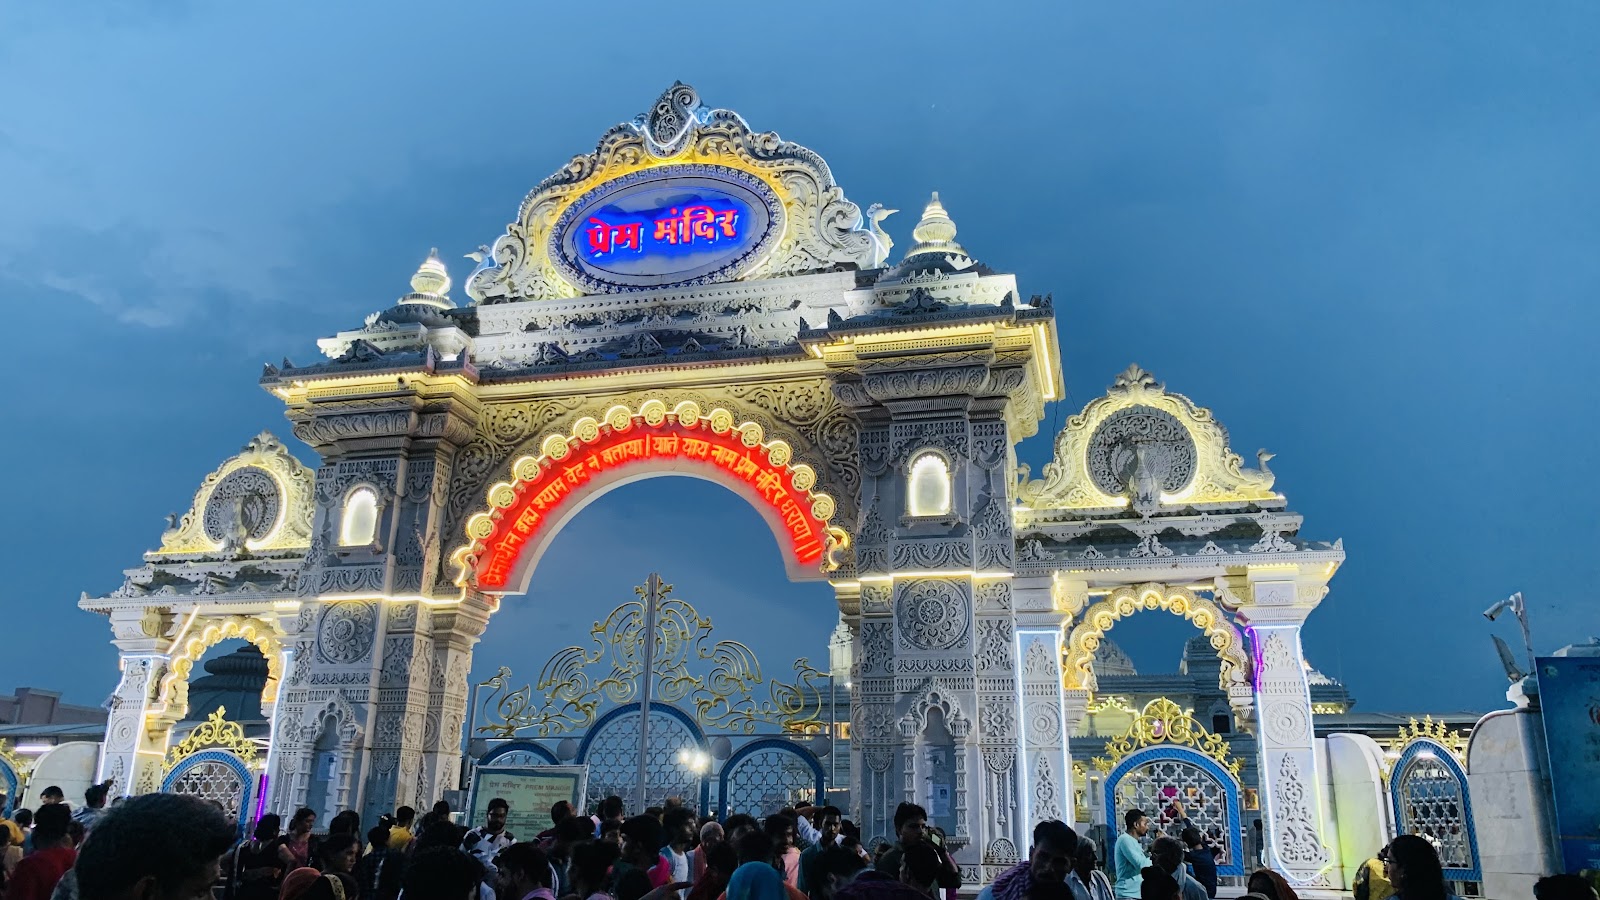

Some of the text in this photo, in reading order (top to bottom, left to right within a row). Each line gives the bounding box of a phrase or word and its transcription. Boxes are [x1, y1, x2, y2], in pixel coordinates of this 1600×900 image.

[587, 205, 738, 254] प्रेम मंदिर
[563, 461, 588, 485] वेद
[711, 444, 740, 470] नाम
[733, 451, 760, 482] प्रेम
[755, 468, 788, 506] मंदिर
